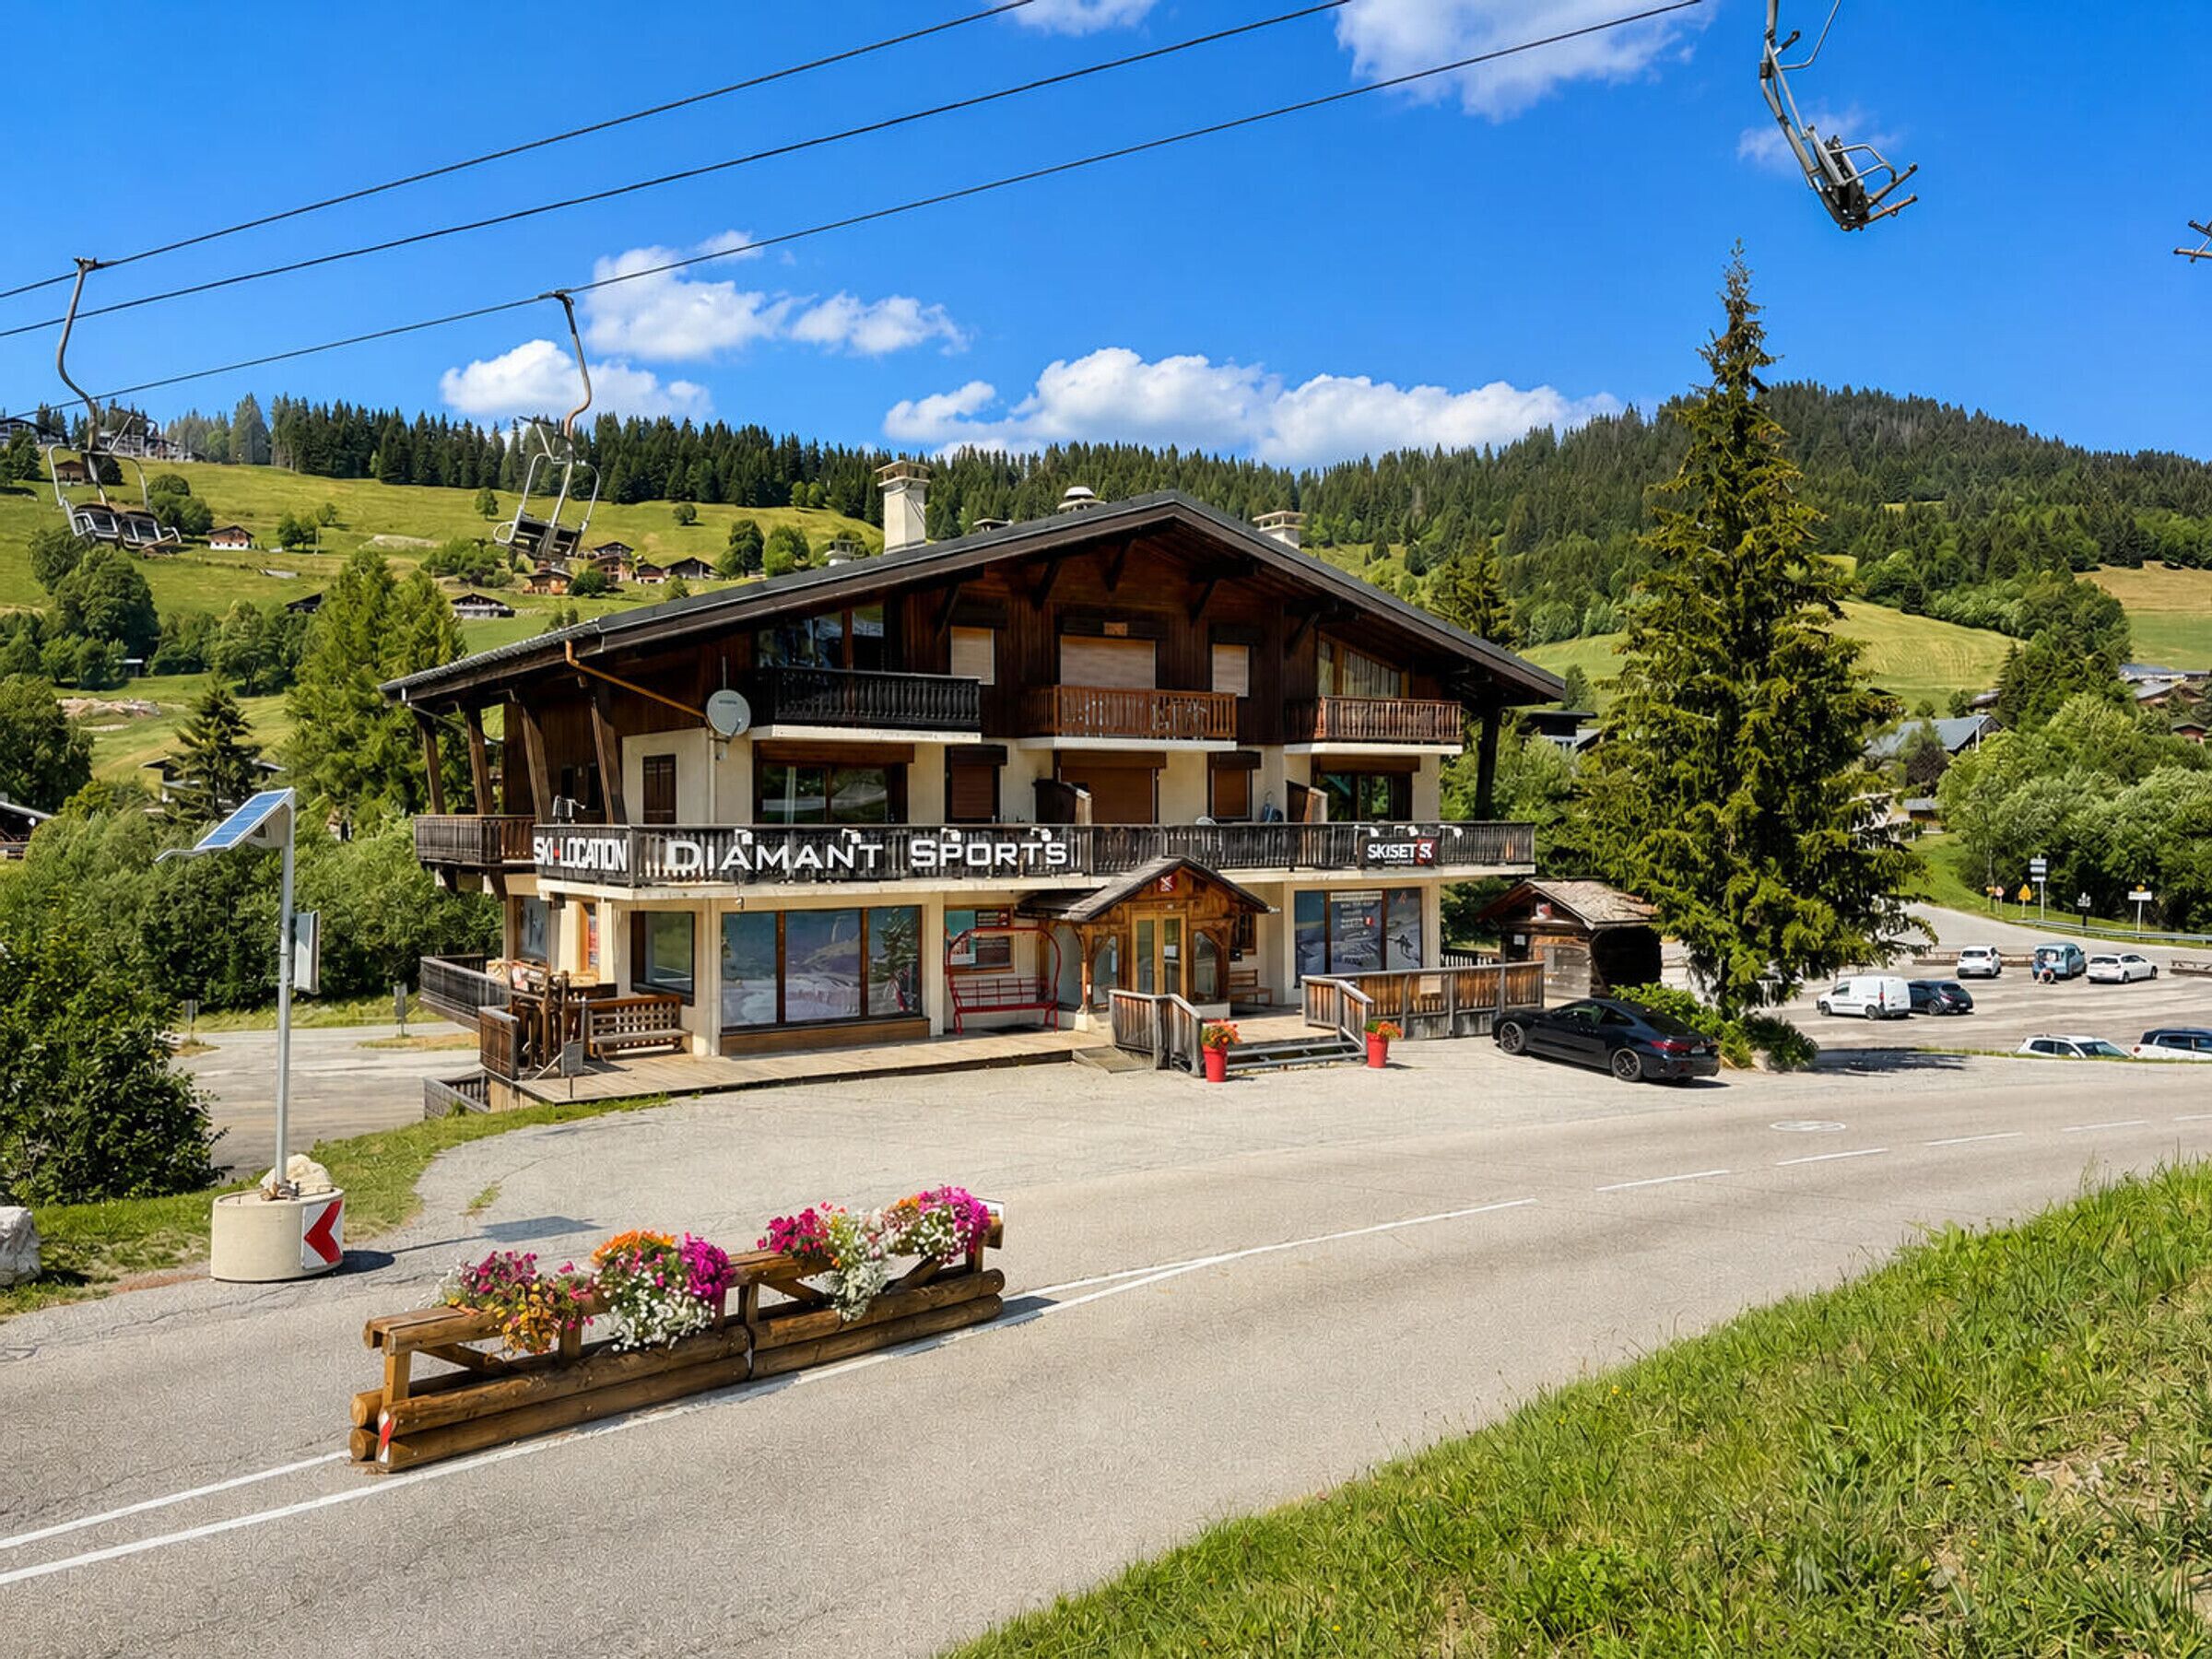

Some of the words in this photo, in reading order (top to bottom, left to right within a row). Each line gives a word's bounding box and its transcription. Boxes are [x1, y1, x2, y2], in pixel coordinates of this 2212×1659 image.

[559, 837, 628, 872] LOCATION
[665, 840, 884, 871] DIAMANT
[911, 840, 1067, 866] SPORTS
[1368, 842, 1418, 859] SKISET
